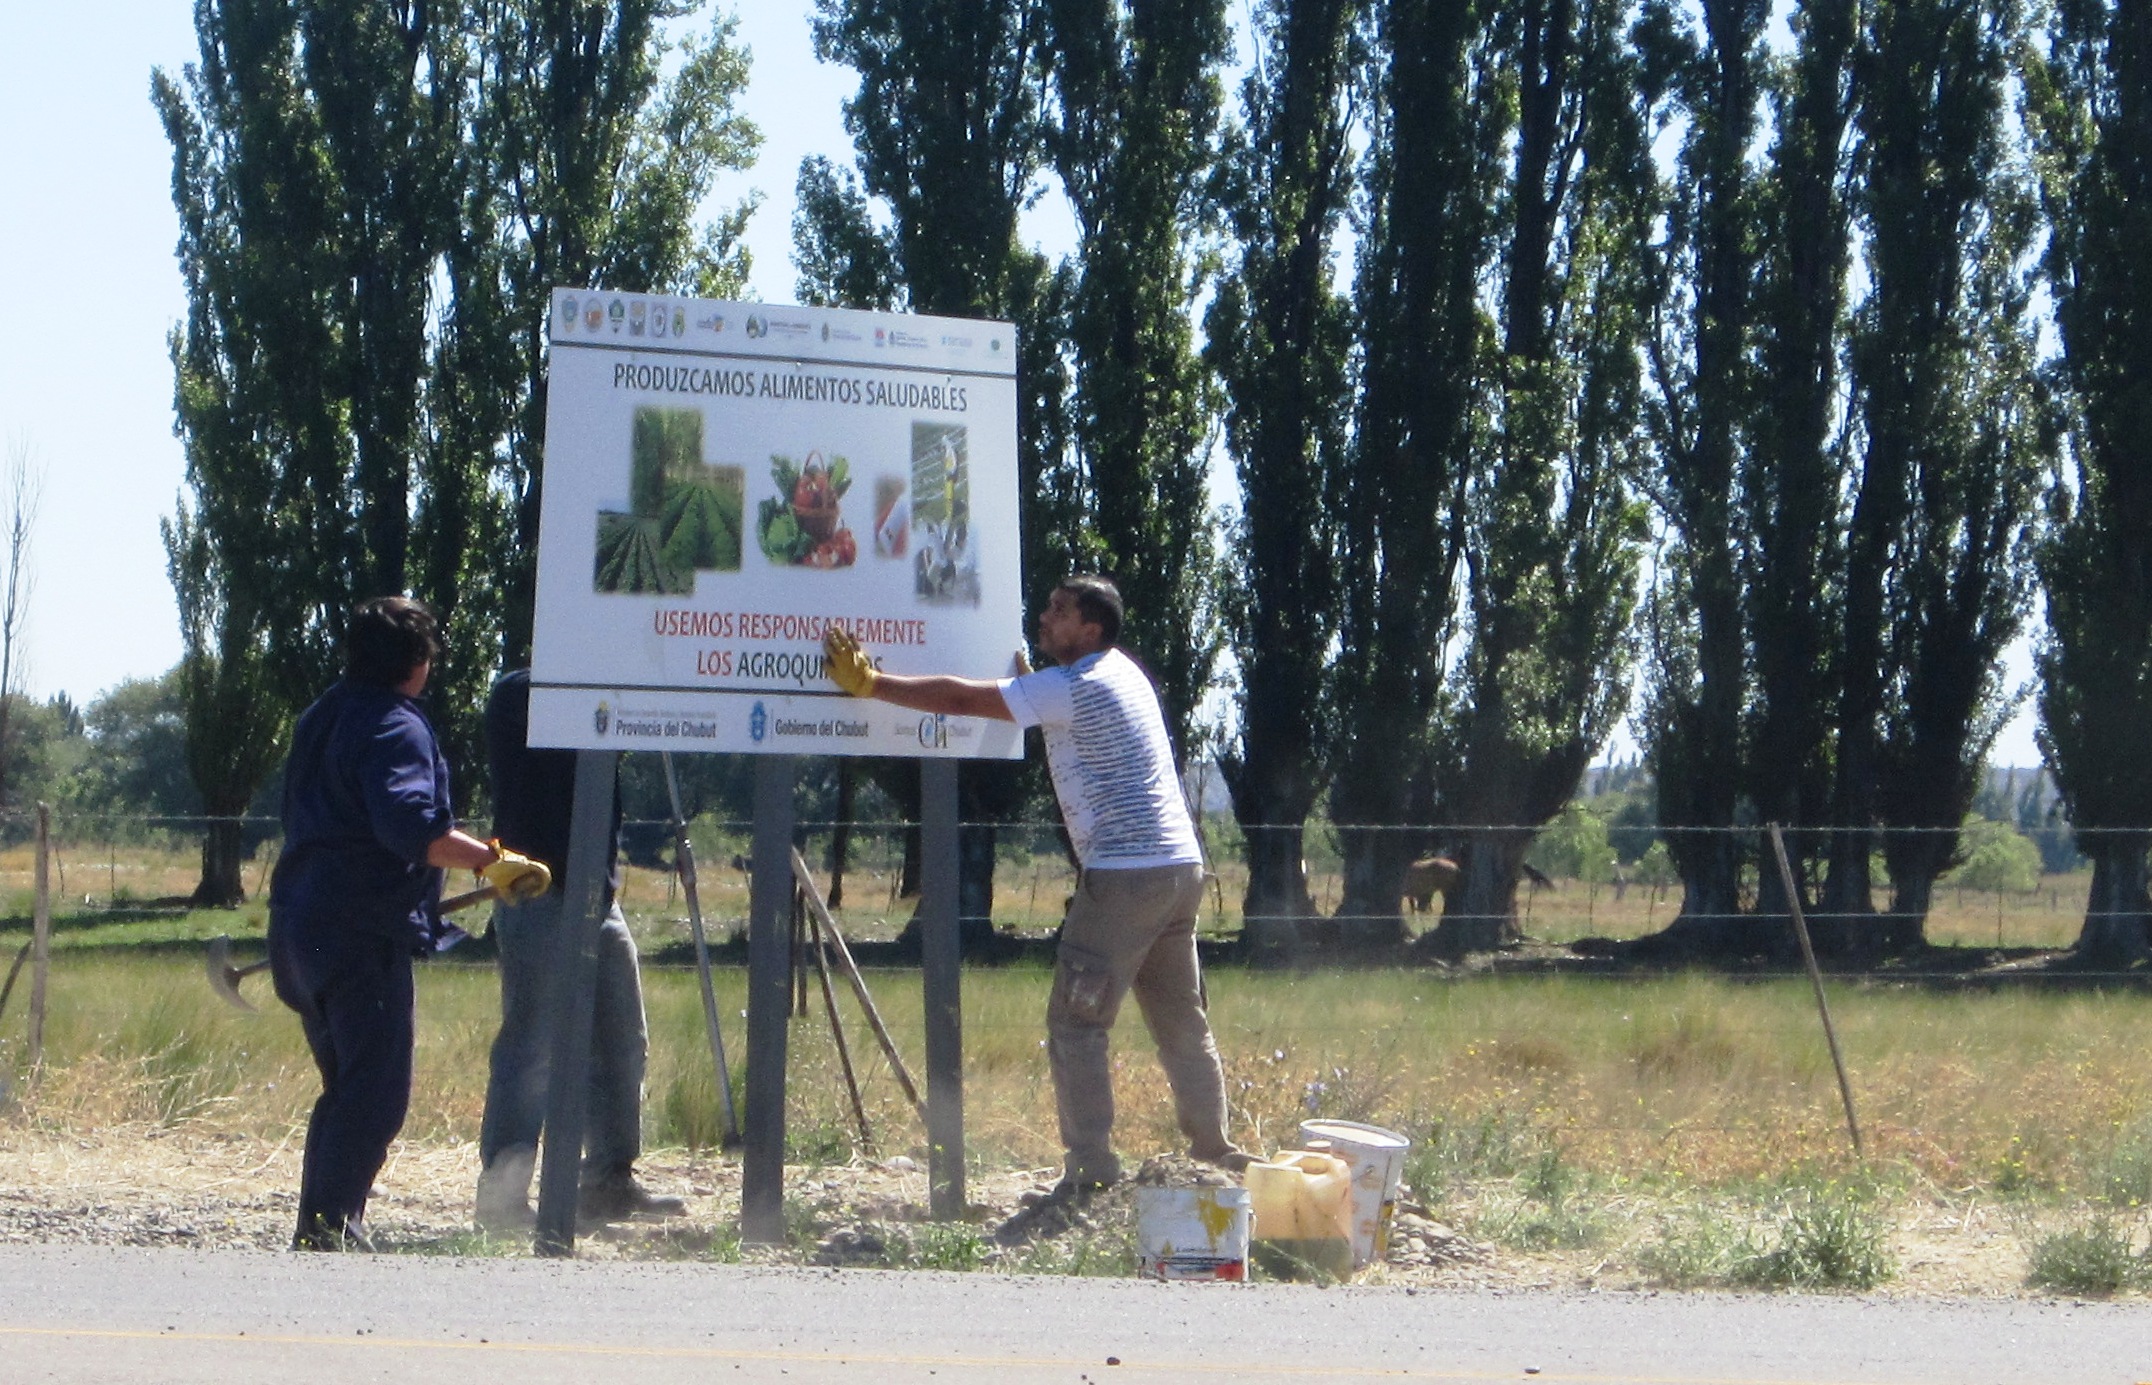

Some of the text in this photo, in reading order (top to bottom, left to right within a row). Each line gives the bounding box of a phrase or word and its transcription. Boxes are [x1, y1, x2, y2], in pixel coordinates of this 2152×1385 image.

[614, 363, 968, 412] PRODUZCAMOS ALIMENTOS SALUDABLES
[654, 611, 733, 638] USEMOS
[697, 651, 732, 676] LOS
[616, 719, 716, 738] Provincia del Chubut
[775, 719, 869, 737] Gobierno del Chubut
